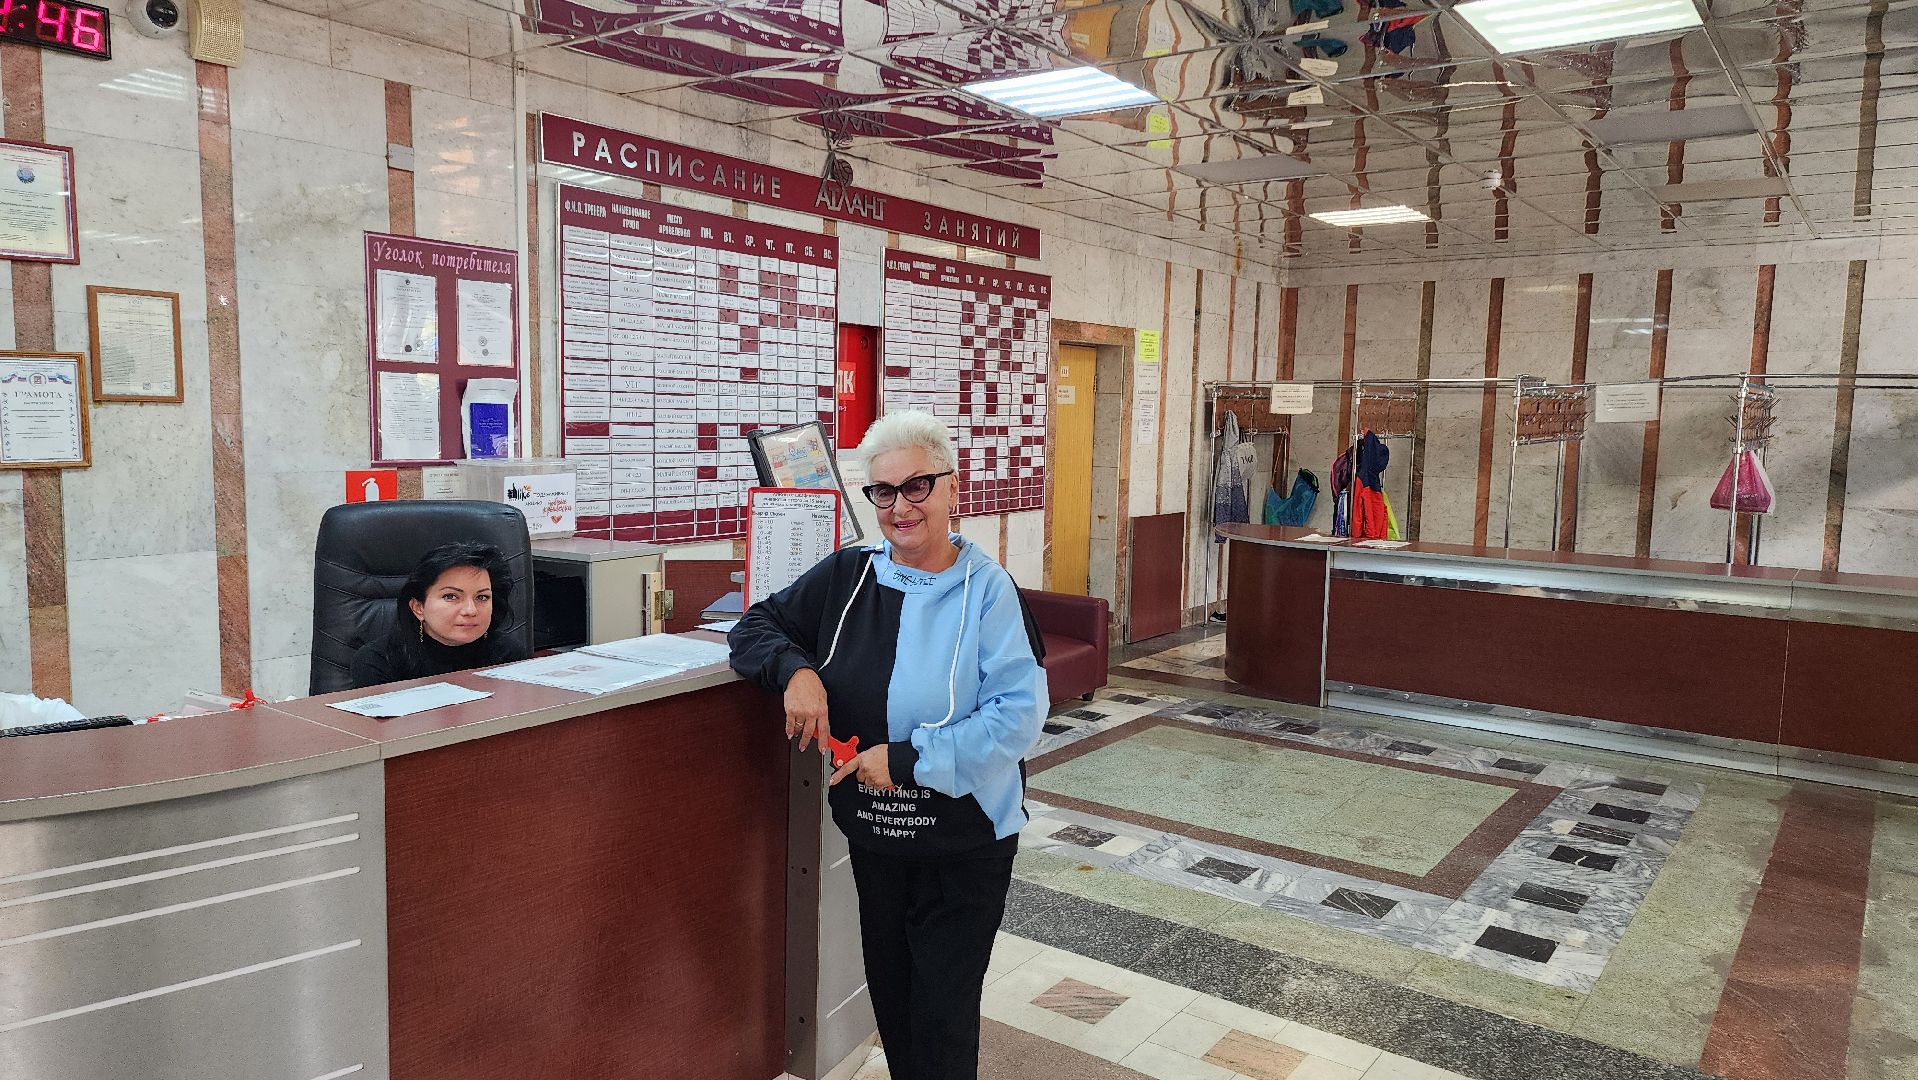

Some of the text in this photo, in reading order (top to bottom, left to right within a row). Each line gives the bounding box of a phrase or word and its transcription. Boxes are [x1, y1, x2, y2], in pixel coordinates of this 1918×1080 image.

[572, 130, 1020, 249] РАСПИСАНИЕ АТЛАНТ ЗАНЯТИЙ
[723, 231, 735, 244] ВТ.
[745, 234, 756, 247] СР.
[765, 238, 776, 251] ЧТ.
[804, 245, 815, 257] СБ.
[823, 248, 833, 260] ВС.
[373, 241, 512, 275] Уголок потребителя
[15, 391, 62, 399] ГРАМОТА
[858, 783, 931, 799] EVERYTHING IS
[871, 800, 916, 812] AMAZING
[856, 809, 937, 827] AND EVERYBODY
[872, 825, 916, 839] IS HAPPY
